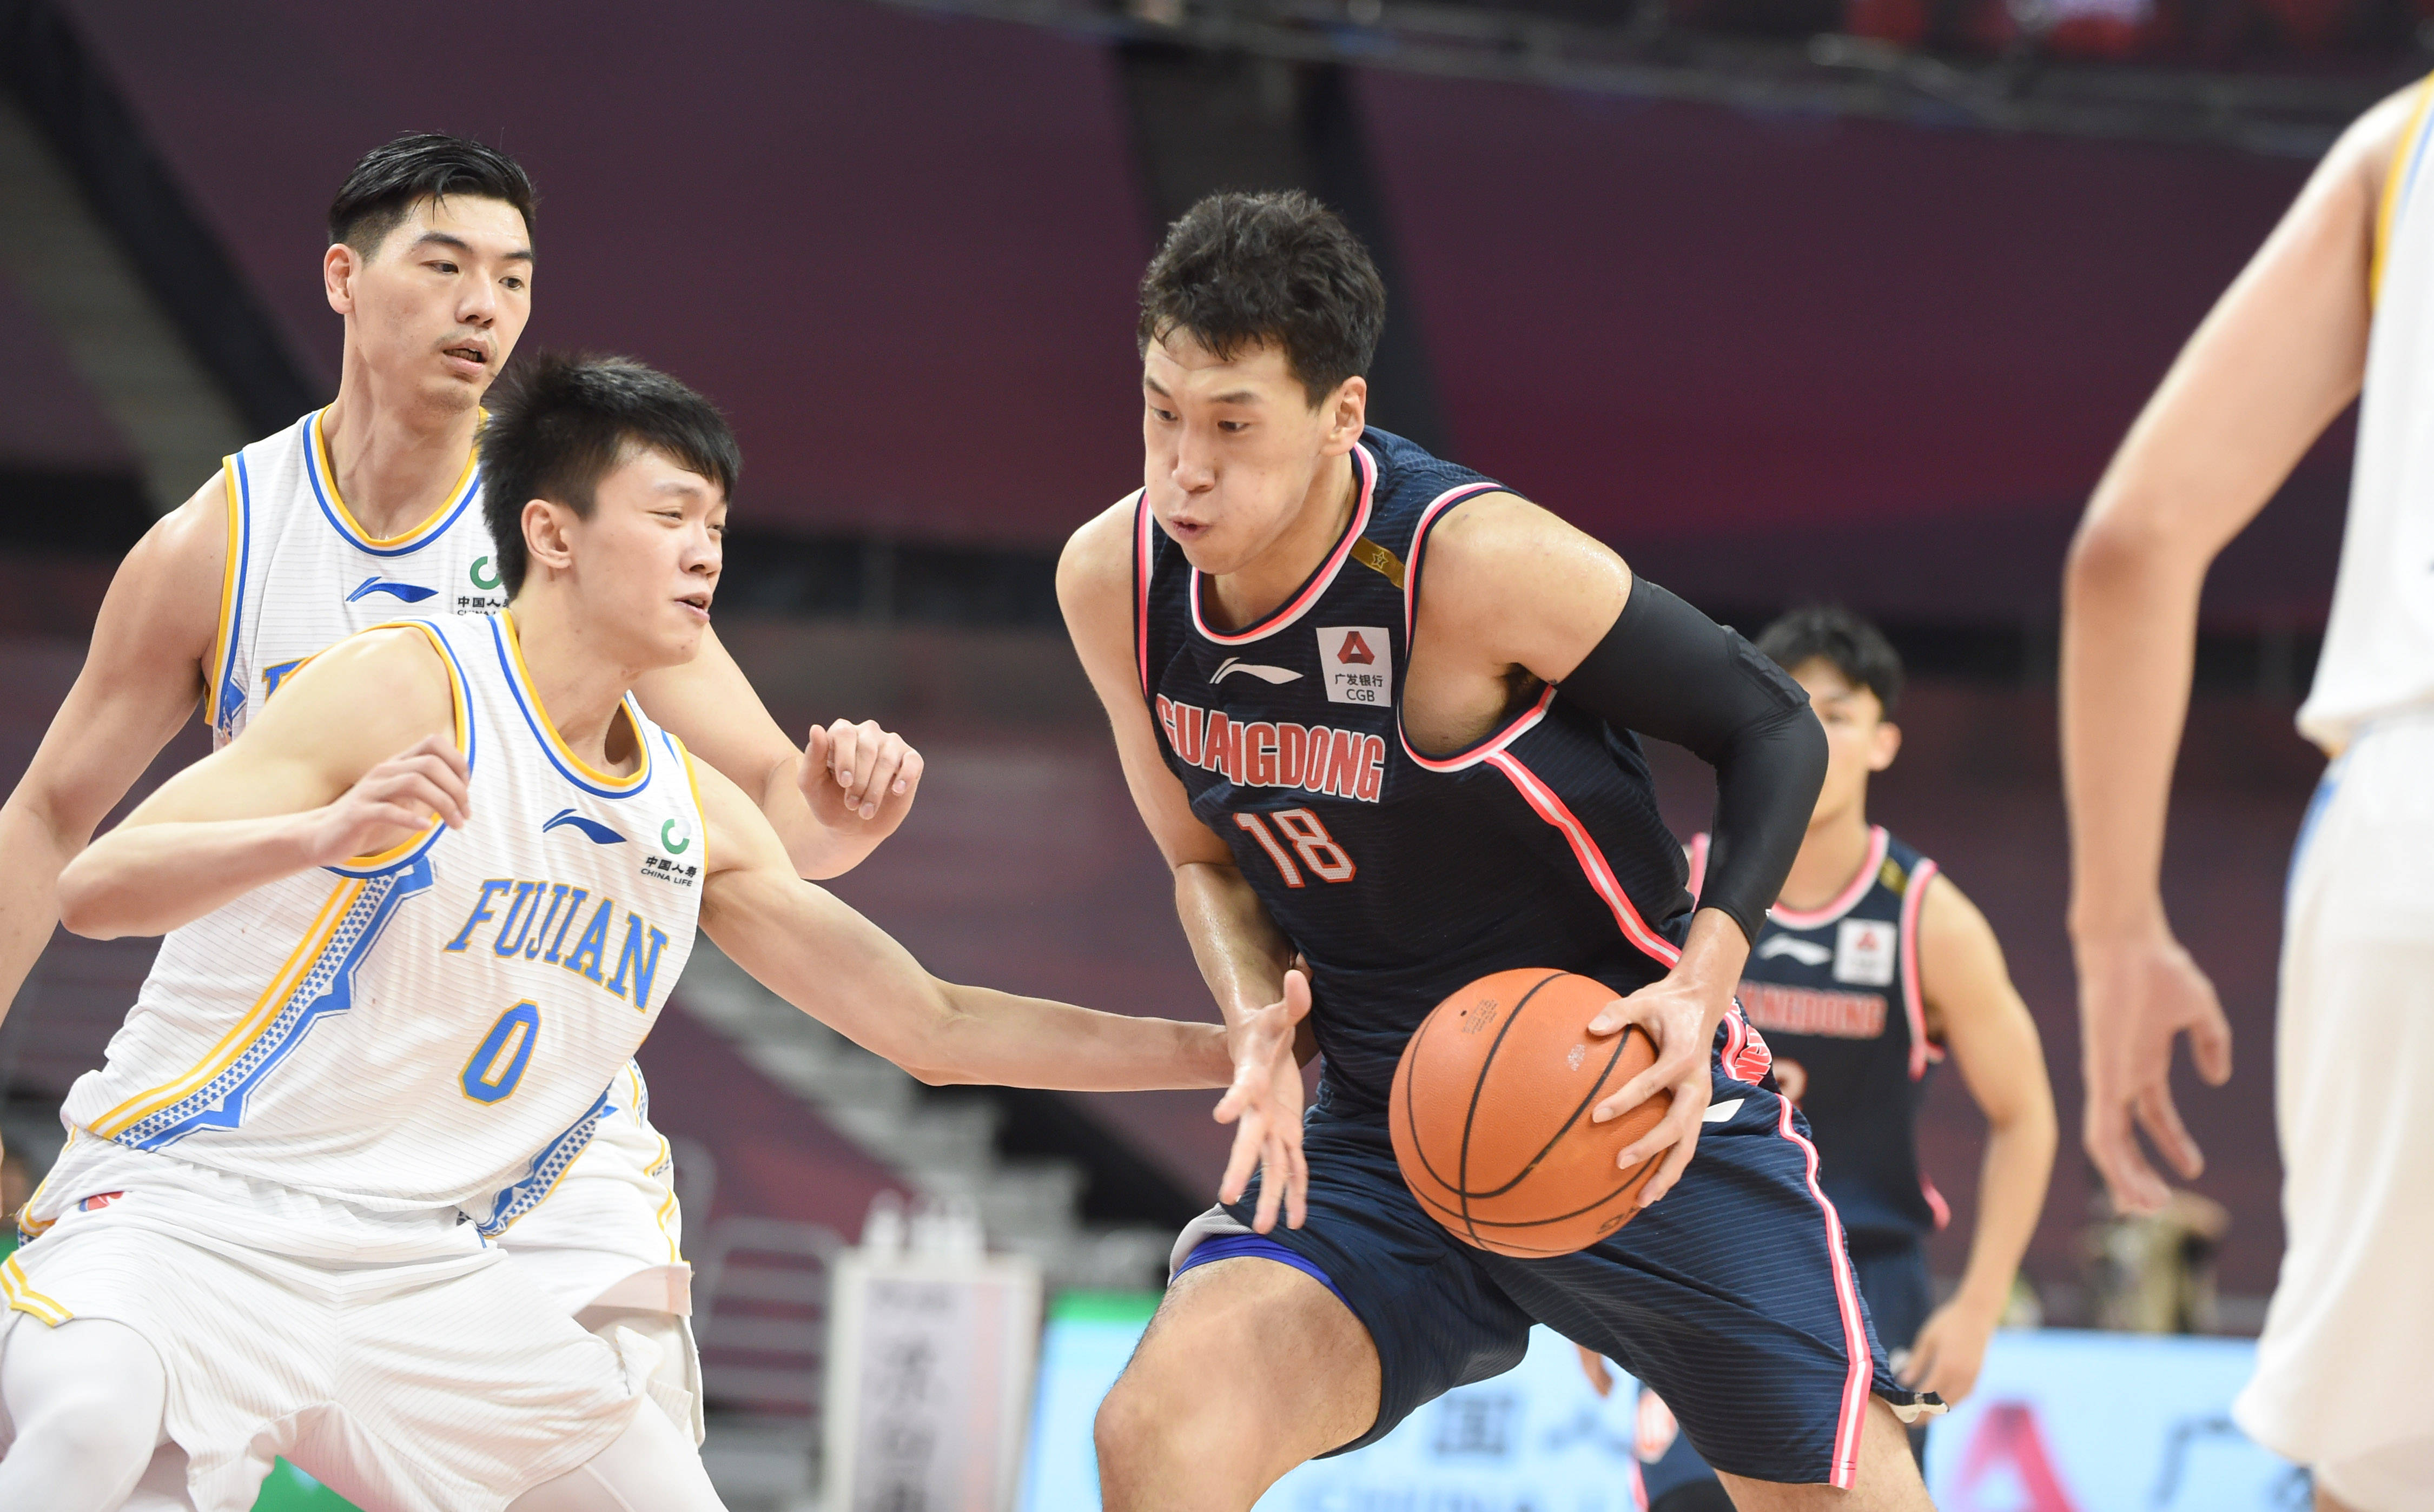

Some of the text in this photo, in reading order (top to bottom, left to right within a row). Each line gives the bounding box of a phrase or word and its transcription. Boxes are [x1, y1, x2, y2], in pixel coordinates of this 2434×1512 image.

[1335, 673, 1383, 687] 广发银行
[1346, 688, 1375, 702] CGB
[1232, 807, 1357, 888] 18
[640, 868, 692, 887] CHINA LIFE
[645, 856, 697, 878] 中国人寿
[443, 878, 670, 1014] FUJIAN
[458, 998, 542, 1106] 0
